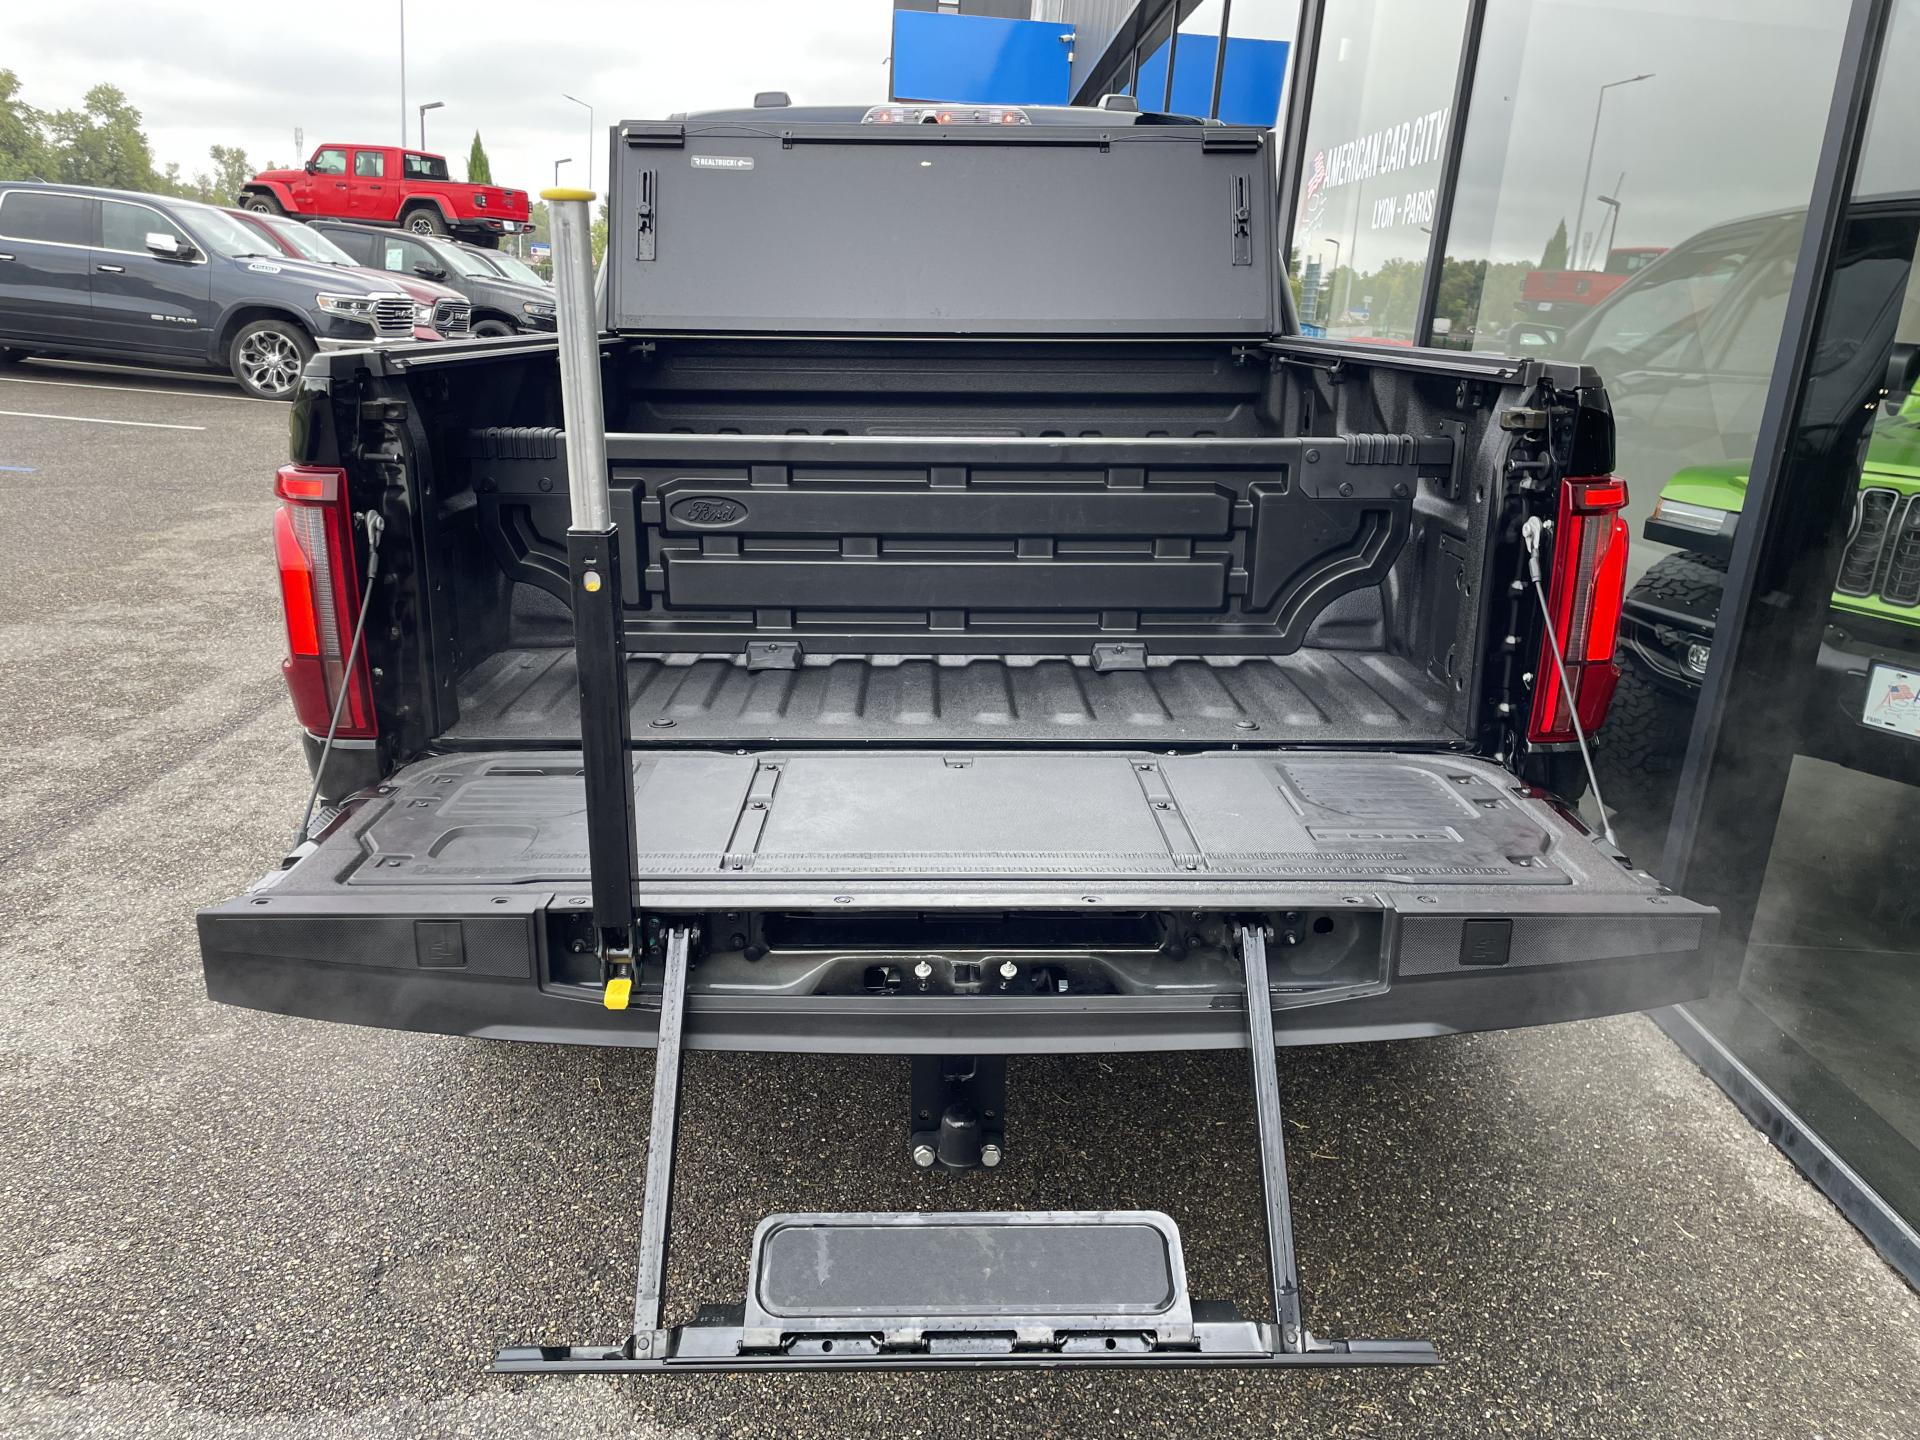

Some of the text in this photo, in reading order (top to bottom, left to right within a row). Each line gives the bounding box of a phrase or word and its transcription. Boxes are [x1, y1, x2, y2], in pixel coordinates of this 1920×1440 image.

[1322, 107, 1449, 189] AMERICAN CAR CITY
[1371, 196, 1397, 229] LYON
[1402, 188, 1436, 225] PARIS
[687, 500, 736, 521] Ford
